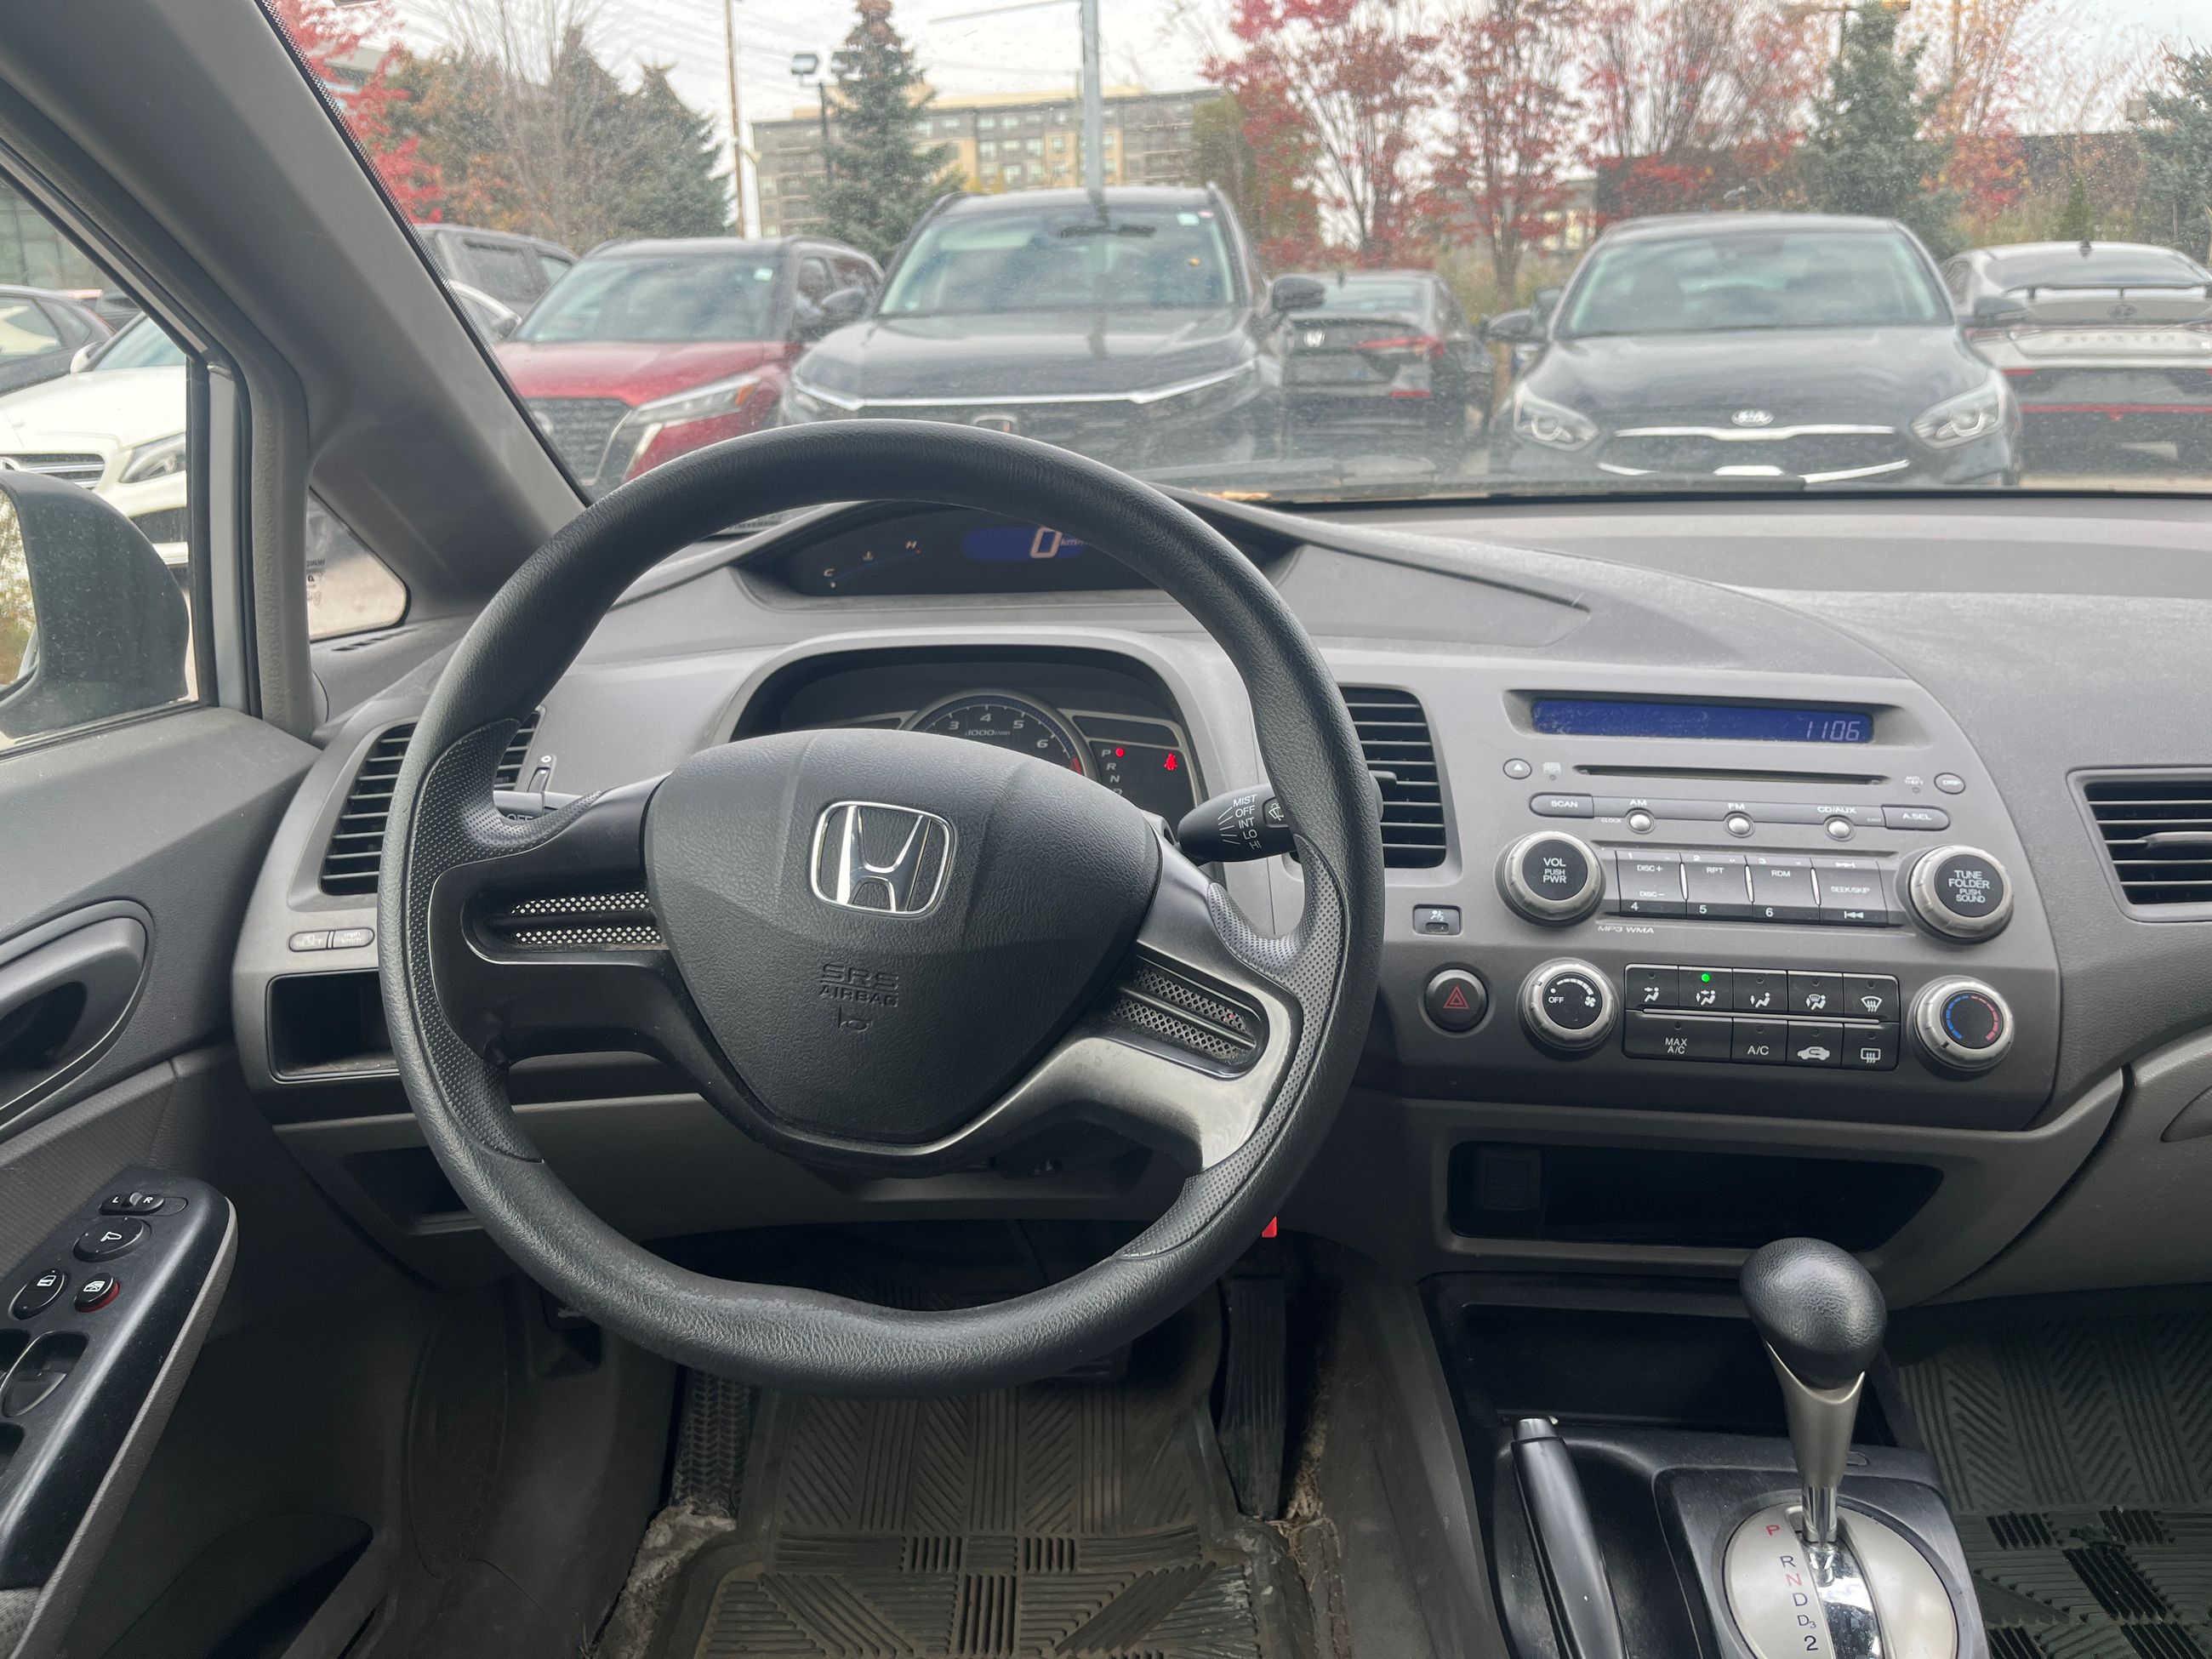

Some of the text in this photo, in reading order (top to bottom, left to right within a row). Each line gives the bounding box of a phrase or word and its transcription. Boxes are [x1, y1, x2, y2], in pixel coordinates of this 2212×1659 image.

[905, 540, 917, 550] H
[1030, 527, 1063, 558] 0
[824, 567, 835, 578] C
[980, 713, 992, 722] 4
[949, 721, 960, 730] 3
[1012, 720, 1024, 729] 5
[1806, 721, 1861, 741] 1106
[1036, 738, 1049, 749] 6
[1101, 749, 1111, 757] P
[1106, 762, 1116, 771] R
[1109, 775, 1120, 784] N
[1233, 793, 1257, 807] MIST
[1551, 800, 1578, 808] SCAN
[1235, 806, 1256, 818] OFF
[1816, 806, 1857, 814] CD/AUX
[1238, 817, 1255, 830] INT
[1243, 829, 1258, 841] LO
[1248, 840, 1262, 850] HI
[1542, 857, 1566, 868] VOL
[1771, 869, 1791, 878] RDM
[1953, 869, 1983, 880] TUNE
[1542, 875, 1567, 884] PWR
[1948, 878, 1991, 890] FOLDER
[1959, 887, 1981, 896] PUSH
[1956, 894, 1987, 904] SOUND
[1630, 901, 1639, 911] 4
[1699, 904, 1707, 914] 5
[1765, 908, 1774, 917] 6
[1626, 926, 1655, 934] WMA
[822, 963, 899, 989] SRS
[819, 985, 899, 1007] AIRBAG
[1548, 995, 1565, 1004] OFF
[1665, 1037, 1688, 1046] MAX
[1667, 1046, 1685, 1055] A/C
[1747, 1046, 1770, 1056] A/C
[1765, 1525, 1780, 1536] P
[1780, 1555, 1796, 1568] R
[1785, 1573, 1802, 1588] N
[1792, 1592, 1808, 1607] D
[1804, 1635, 1819, 1651] 2
